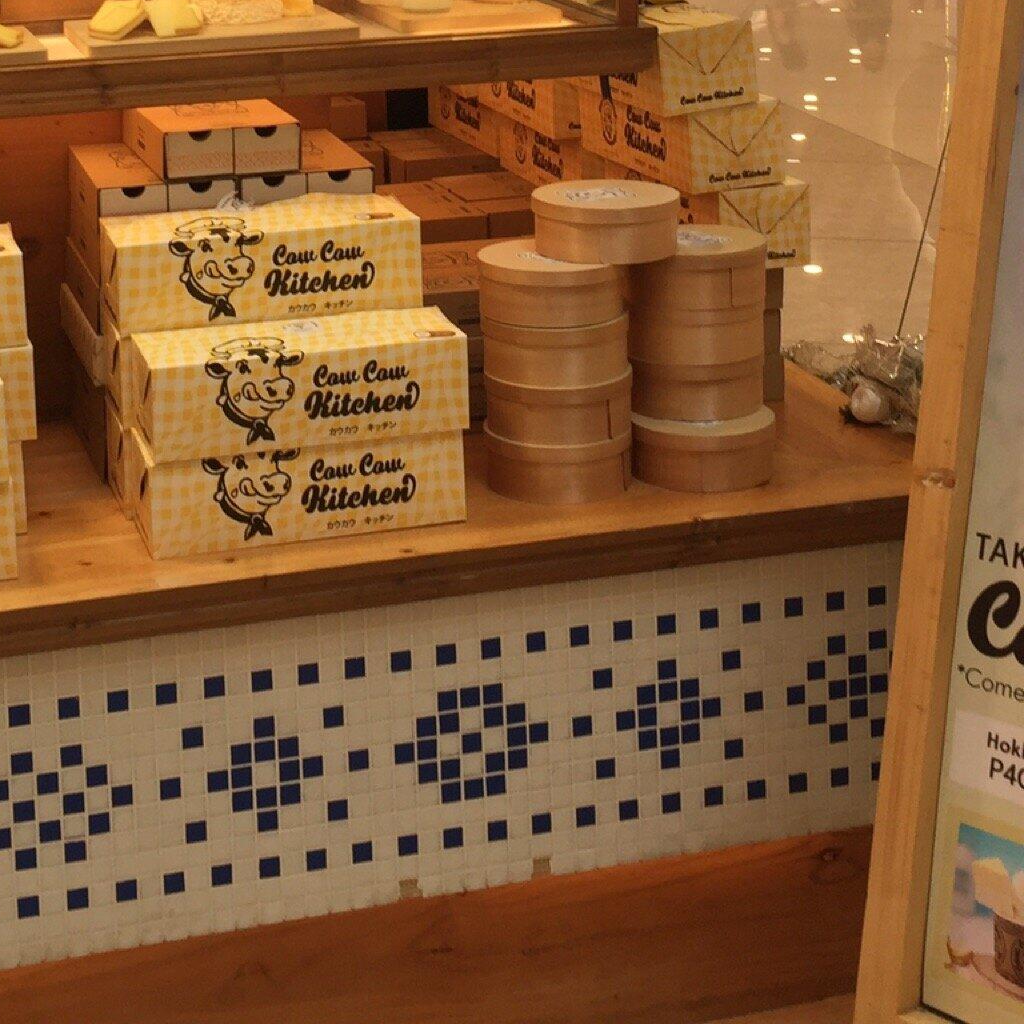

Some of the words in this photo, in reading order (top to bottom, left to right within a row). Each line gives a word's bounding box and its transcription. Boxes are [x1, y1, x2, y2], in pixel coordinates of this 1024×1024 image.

[625, 123, 668, 162] Kitchen
[272, 244, 317, 266] Cow
[319, 240, 364, 263] Cow
[263, 262, 376, 298] Kitchen
[312, 364, 360, 387] Cow
[363, 359, 409, 383] Cow
[304, 382, 420, 420] Kitchen
[309, 459, 356, 481] Cow
[358, 452, 406, 475] Cow
[301, 474, 416, 515] Kitchen
[967, 580, 1024, 666] C
